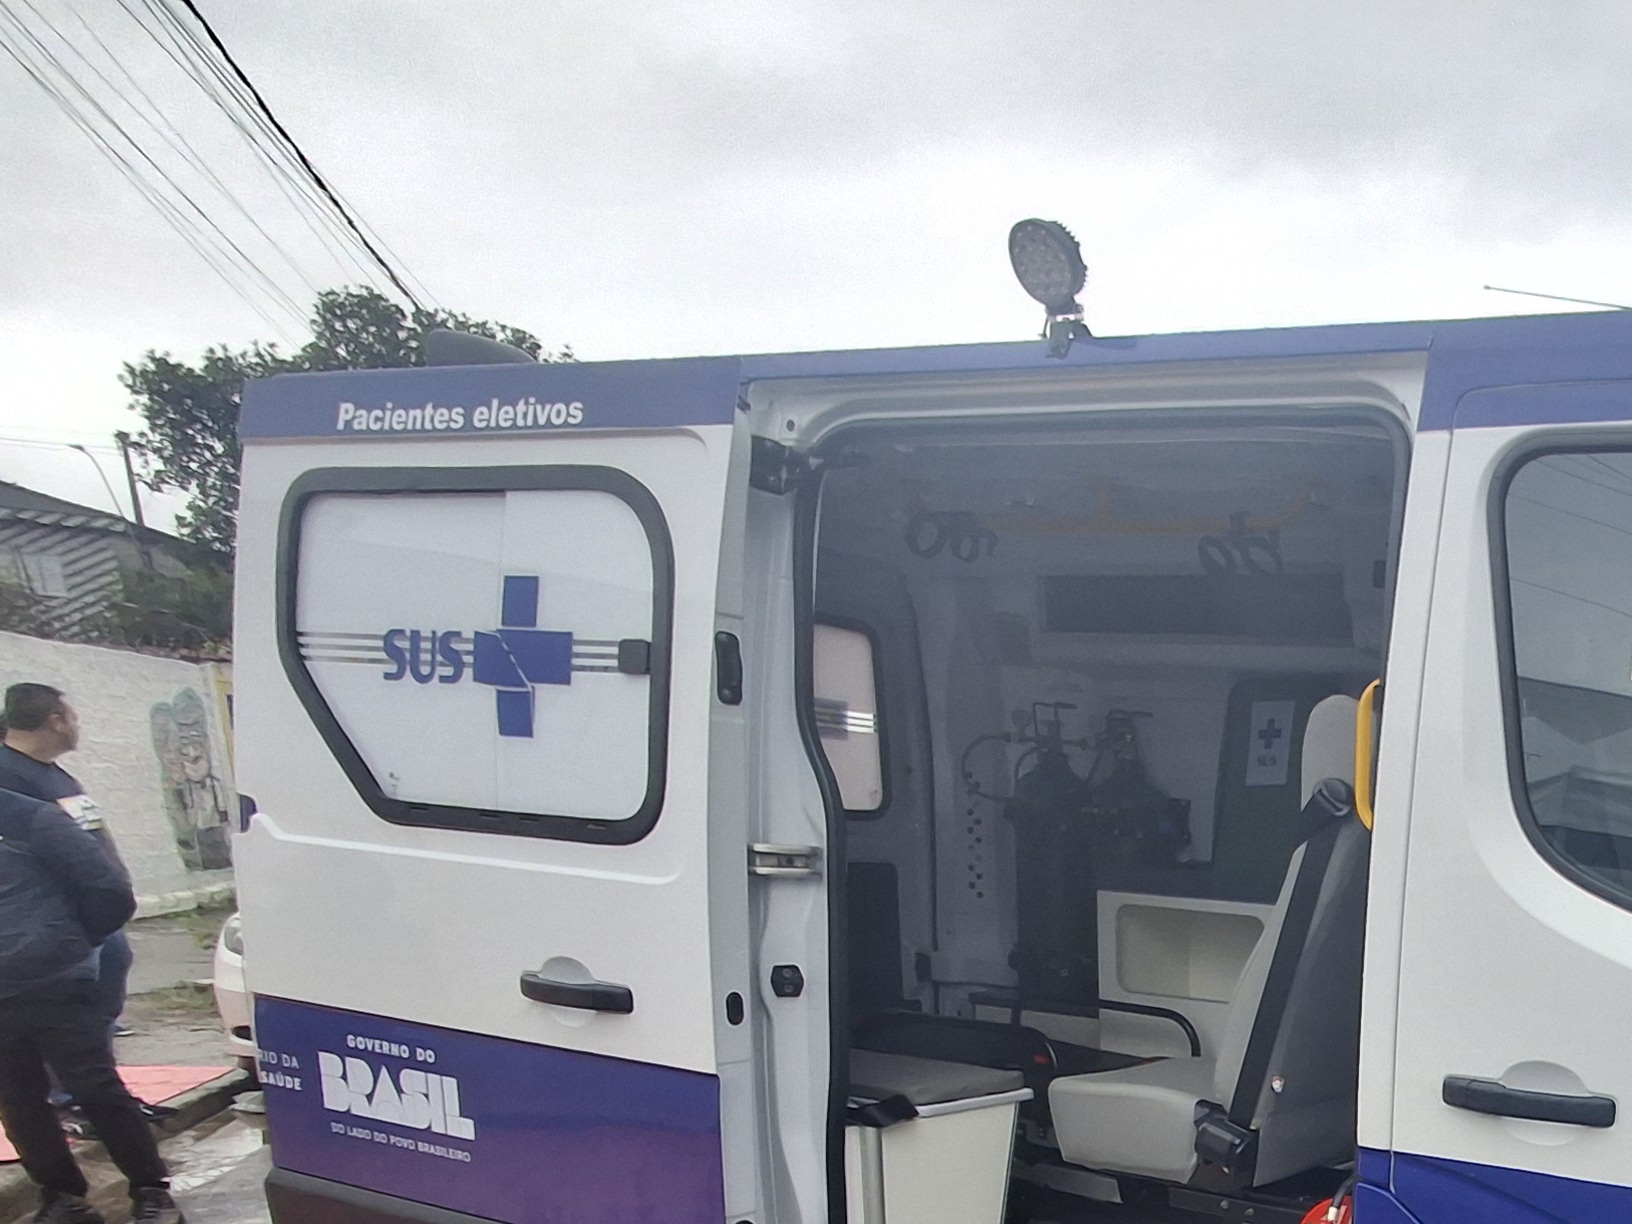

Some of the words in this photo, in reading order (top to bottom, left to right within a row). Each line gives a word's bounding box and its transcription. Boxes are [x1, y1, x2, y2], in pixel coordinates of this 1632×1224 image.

[336, 402, 465, 430] Pacientes
[472, 397, 584, 428] eletivos
[383, 628, 464, 684] SUS
[281, 1053, 300, 1070] DA
[346, 1034, 410, 1059] GOVERNO
[415, 1047, 436, 1063] DO
[317, 1051, 476, 1141] BRASIL
[330, 1122, 345, 1134] DO
[347, 1125, 372, 1140] LADO
[373, 1131, 388, 1144] DO
[389, 1135, 416, 1151] POVO
[417, 1141, 471, 1163] BRASILEIRO
